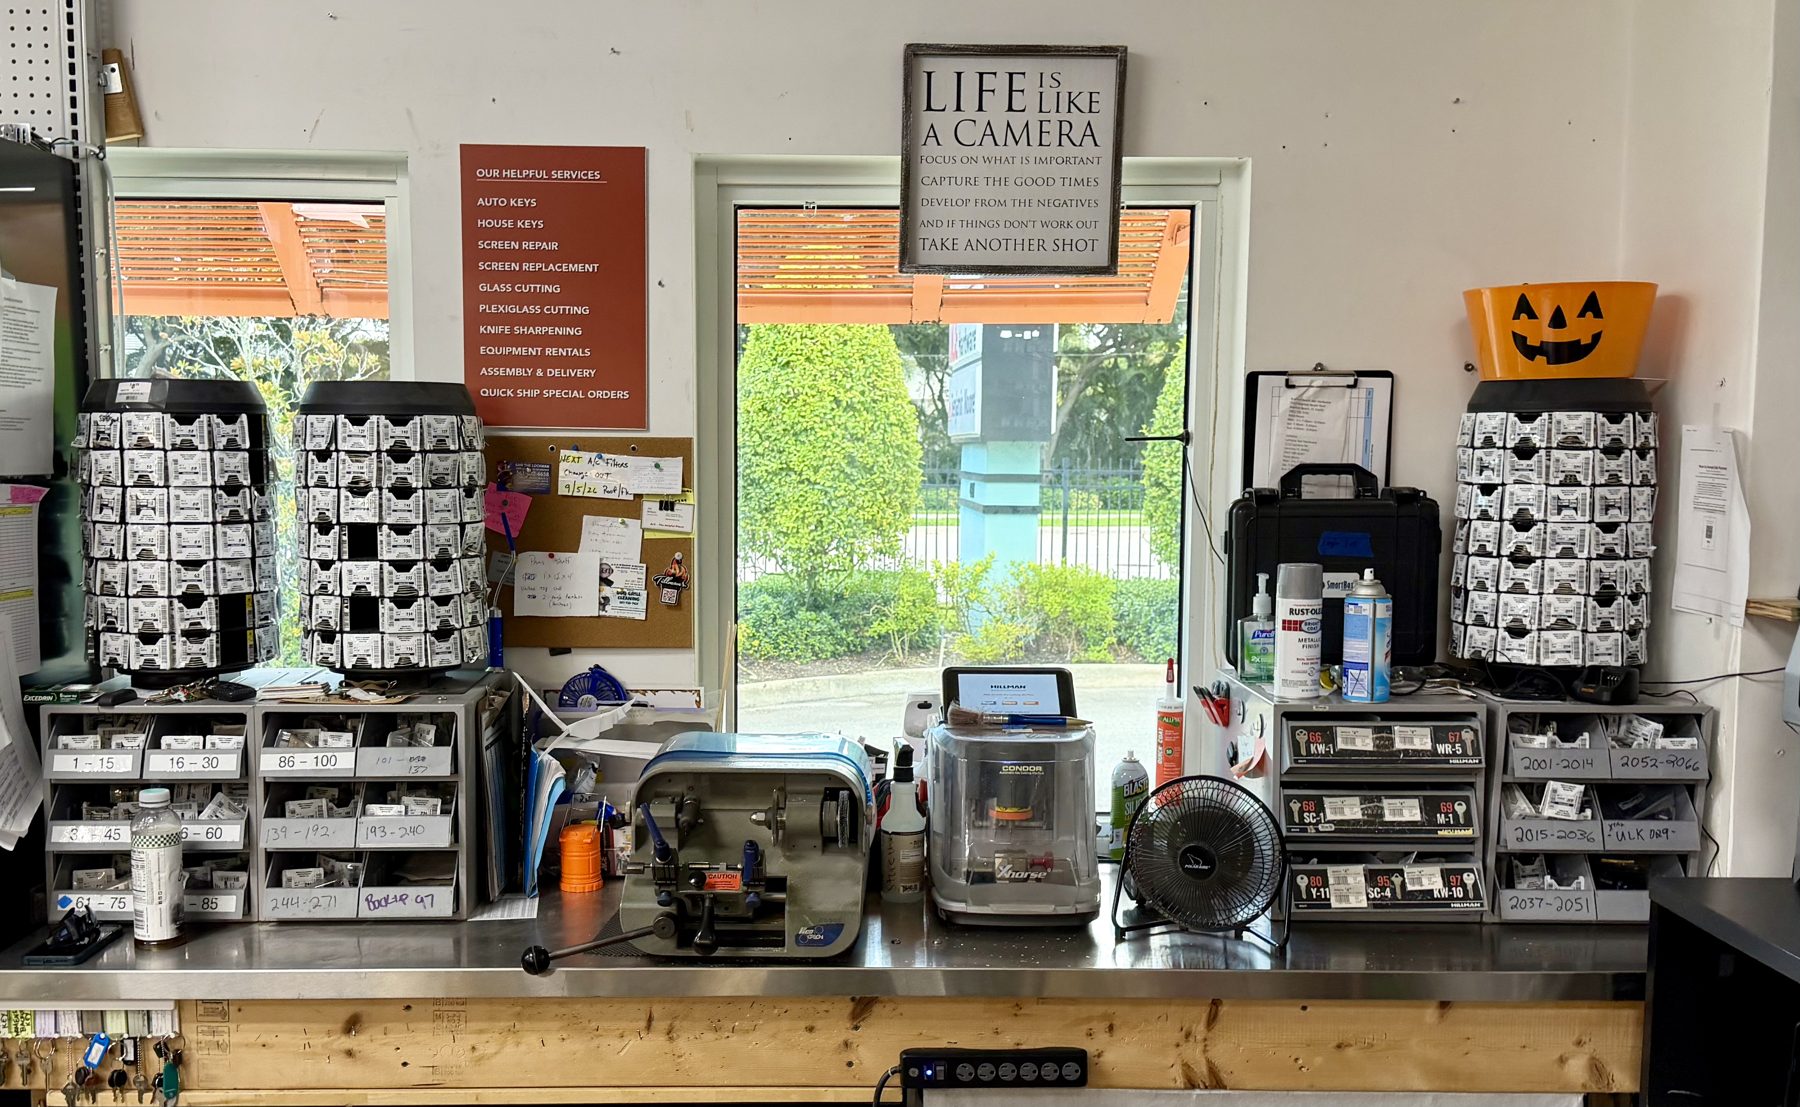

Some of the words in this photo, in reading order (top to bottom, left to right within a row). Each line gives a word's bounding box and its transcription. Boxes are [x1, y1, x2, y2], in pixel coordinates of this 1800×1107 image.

[922, 70, 1027, 113] LIFE
[1039, 72, 1062, 89] IS
[1038, 91, 1101, 114] LIKE
[921, 123, 943, 147] A
[954, 118, 1102, 148] CAMERA
[919, 155, 957, 165] FOCUS
[960, 155, 979, 165] ON
[981, 156, 1016, 165] WHAT
[1020, 156, 1030, 165] IS
[1034, 156, 1103, 166] IMPORTANT
[476, 169, 500, 178] OUR
[502, 170, 549, 179] HELPFUL
[551, 171, 601, 180] SERVICES
[920, 176, 980, 187] CAPTURE
[983, 176, 1010, 187] THE
[1013, 176, 1056, 187] GOOD
[1059, 177, 1100, 188] TIMES
[477, 198, 507, 207] AUTO
[510, 198, 537, 207] KEYS
[921, 198, 971, 208] DEVELOP
[974, 198, 1007, 208] FROM
[1010, 198, 1034, 208] THE
[1037, 198, 1099, 208] NEGATIVES
[477, 219, 514, 228] HOUSE
[517, 220, 544, 229] KEYS
[919, 219, 944, 229] AND
[946, 219, 957, 229] IF
[959, 219, 1001, 229] THINGS
[1003, 219, 1038, 229] DON'T
[1040, 219, 1074, 229] WORK
[1075, 220, 1100, 230] OUT
[478, 240, 519, 250] SCREEN
[522, 241, 559, 251] REPAIR
[918, 237, 959, 251] TAKE
[964, 238, 1047, 252] ANOTHER
[1052, 238, 1099, 252] SHOT
[478, 262, 520, 271] SCREEN
[522, 263, 599, 272] REPLACEMENT
[479, 283, 512, 293] GLASS
[514, 284, 561, 293] CUTTING
[479, 305, 541, 314] PLEXIGLASS
[544, 305, 590, 315] CUTTING
[479, 325, 511, 335] KNIFE
[513, 326, 583, 336] SHARPENING
[480, 346, 542, 356] EQUIPMENT
[545, 347, 591, 357] RENTALS
[480, 368, 533, 377] ASSEMBLY
[536, 369, 544, 377] &
[546, 368, 597, 378] DELIVERY
[480, 388, 514, 398] QUICK
[516, 389, 540, 398] SHIP
[543, 389, 585, 399] SPECIAL
[587, 390, 630, 399] ORDERS
[560, 455, 582, 463] NEXT
[1308, 732, 1322, 743] 66
[1448, 732, 1461, 743] 67
[1310, 743, 1334, 755] KW-1
[1436, 743, 1462, 755] WR-5
[99, 757, 114, 769] 15
[169, 757, 185, 769] 16
[202, 757, 219, 769] 30
[278, 756, 295, 769] 86
[313, 754, 338, 768] 100
[1521, 757, 1594, 771] 2001-2014
[1620, 754, 1700, 772] 2052-2066
[1302, 800, 1315, 812] 68
[1440, 801, 1453, 813] 69
[1303, 812, 1325, 824] SC-1
[1436, 813, 1454, 825] M-1
[104, 828, 121, 841] 45
[205, 827, 223, 840] 60
[1514, 826, 1595, 843] 2015-2036
[997, 864, 1048, 878] Xhorse
[1310, 876, 1322, 887] 80
[1377, 876, 1390, 887] 95
[1449, 875, 1461, 886] 97
[1311, 888, 1330, 899] Y-11
[1368, 888, 1391, 899] SC-4
[1433, 887, 1464, 899] KW-10
[110, 897, 126, 910] 75
[201, 897, 219, 910] 85
[1509, 896, 1590, 913] 2037-2051
